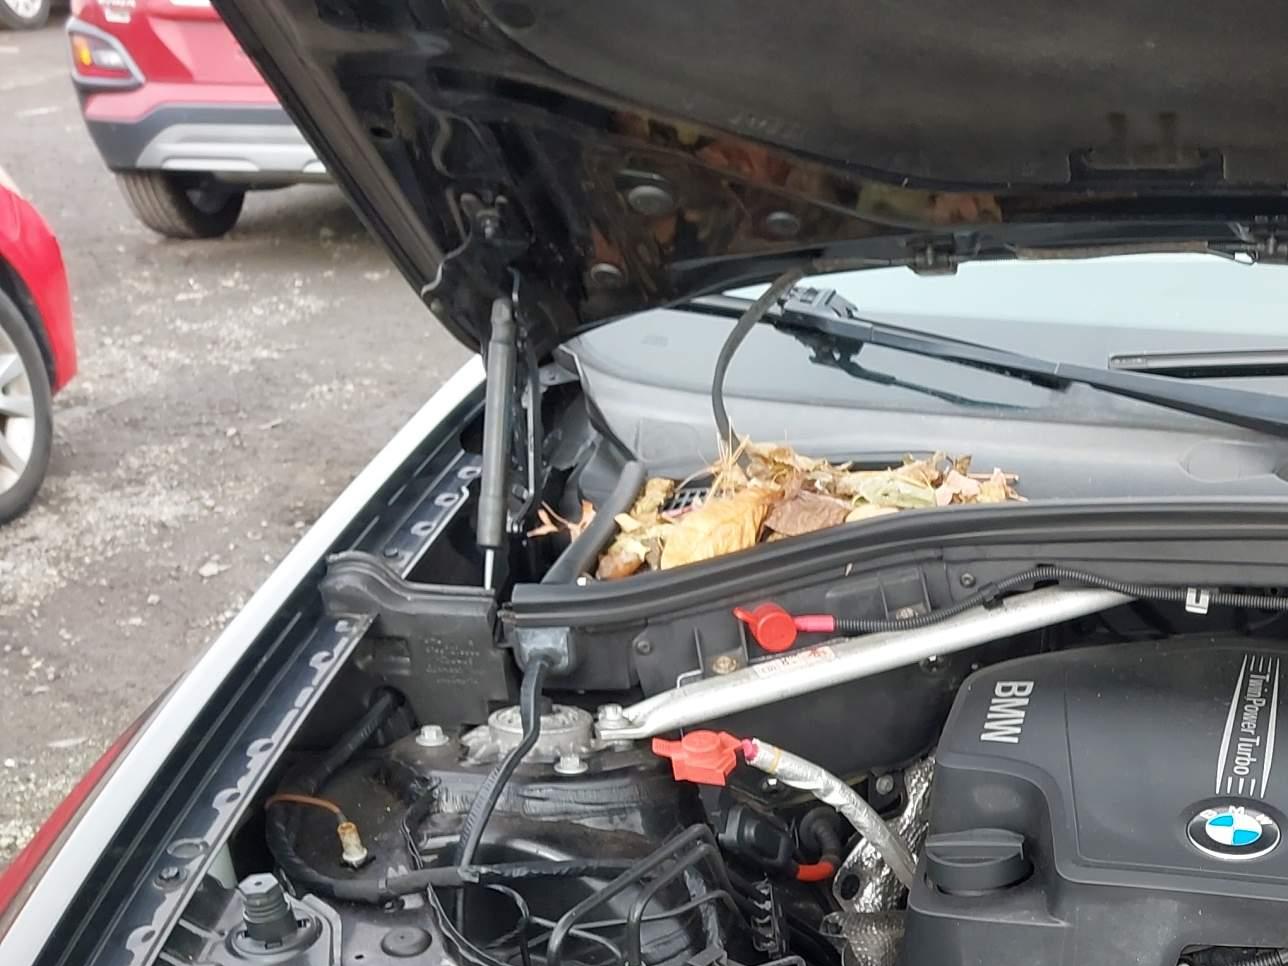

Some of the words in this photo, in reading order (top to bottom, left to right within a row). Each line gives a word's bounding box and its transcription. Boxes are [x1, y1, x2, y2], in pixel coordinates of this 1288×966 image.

[981, 680, 1035, 744] BMW
[1240, 673, 1271, 736] TwinPower
[1233, 736, 1261, 776] Turbo
